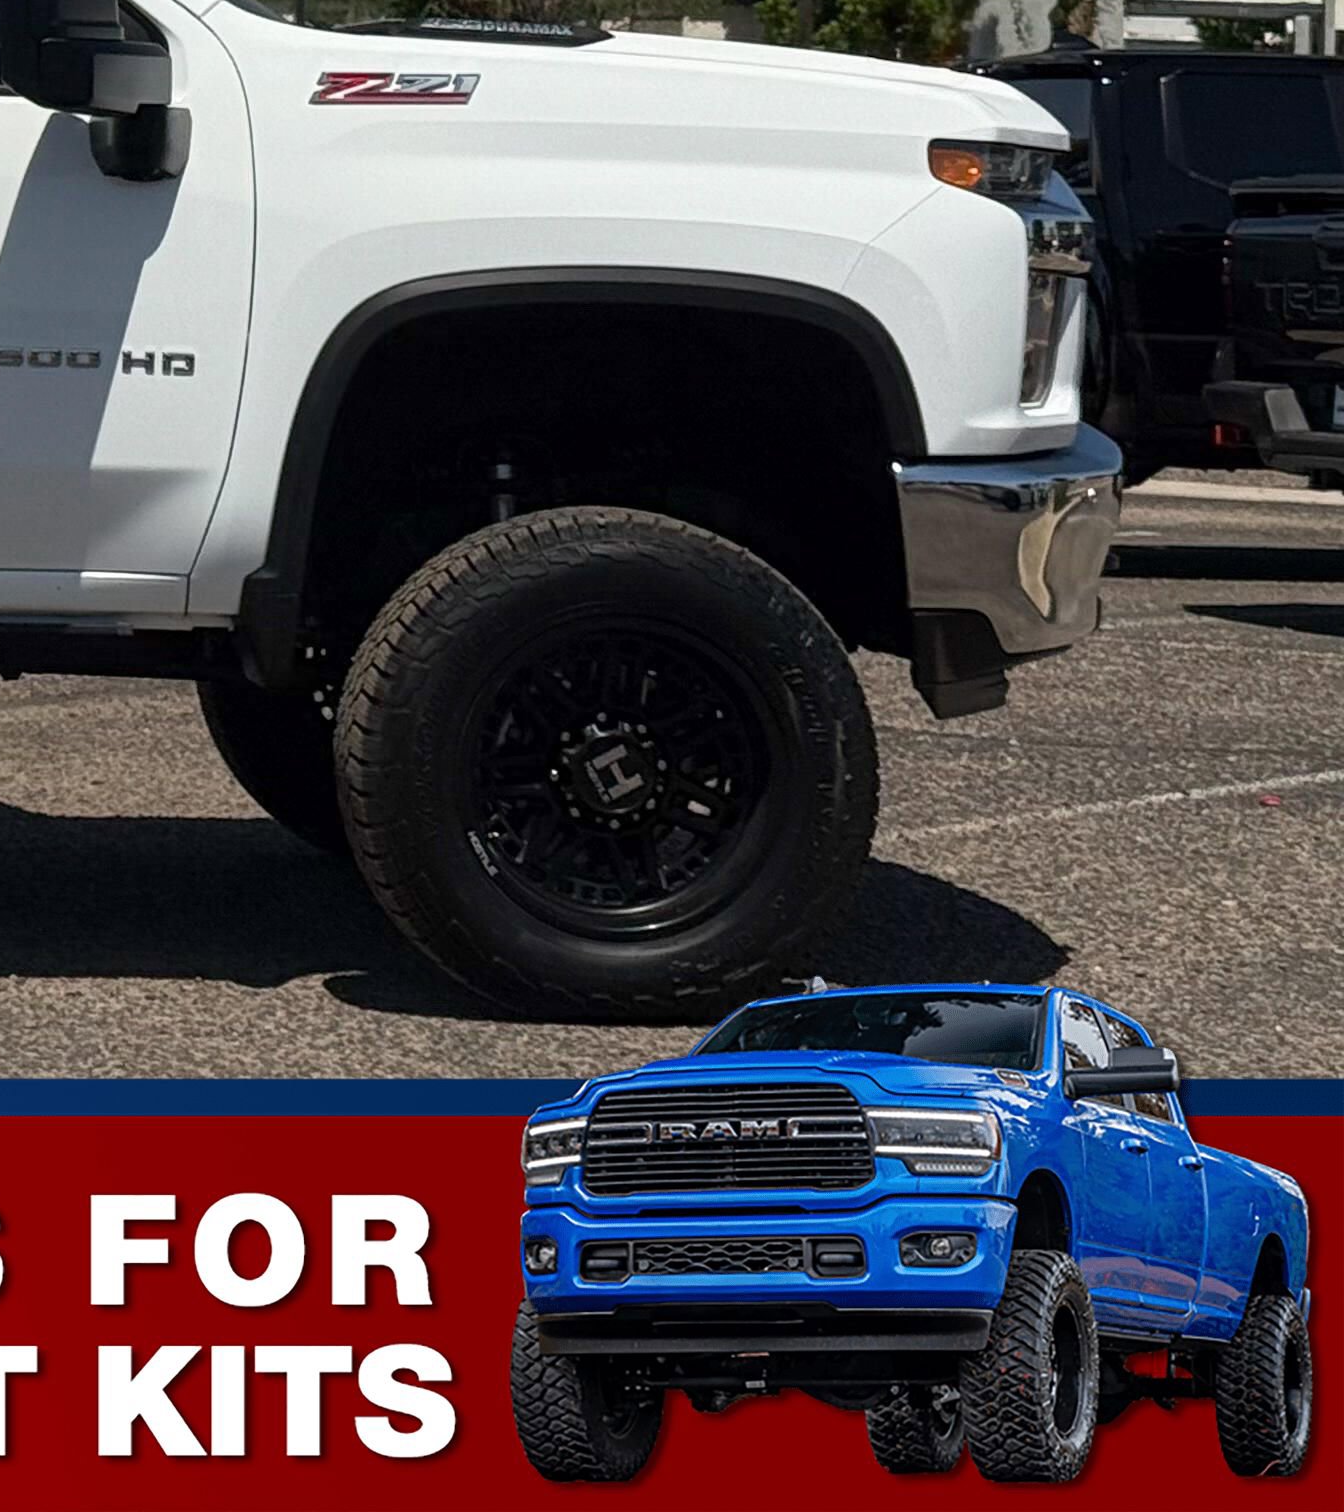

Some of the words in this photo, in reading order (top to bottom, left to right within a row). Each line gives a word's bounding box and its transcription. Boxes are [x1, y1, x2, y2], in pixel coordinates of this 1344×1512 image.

[483, 20, 574, 36] DURAMAX
[308, 70, 482, 106] Z71
[121, 350, 196, 377] HD
